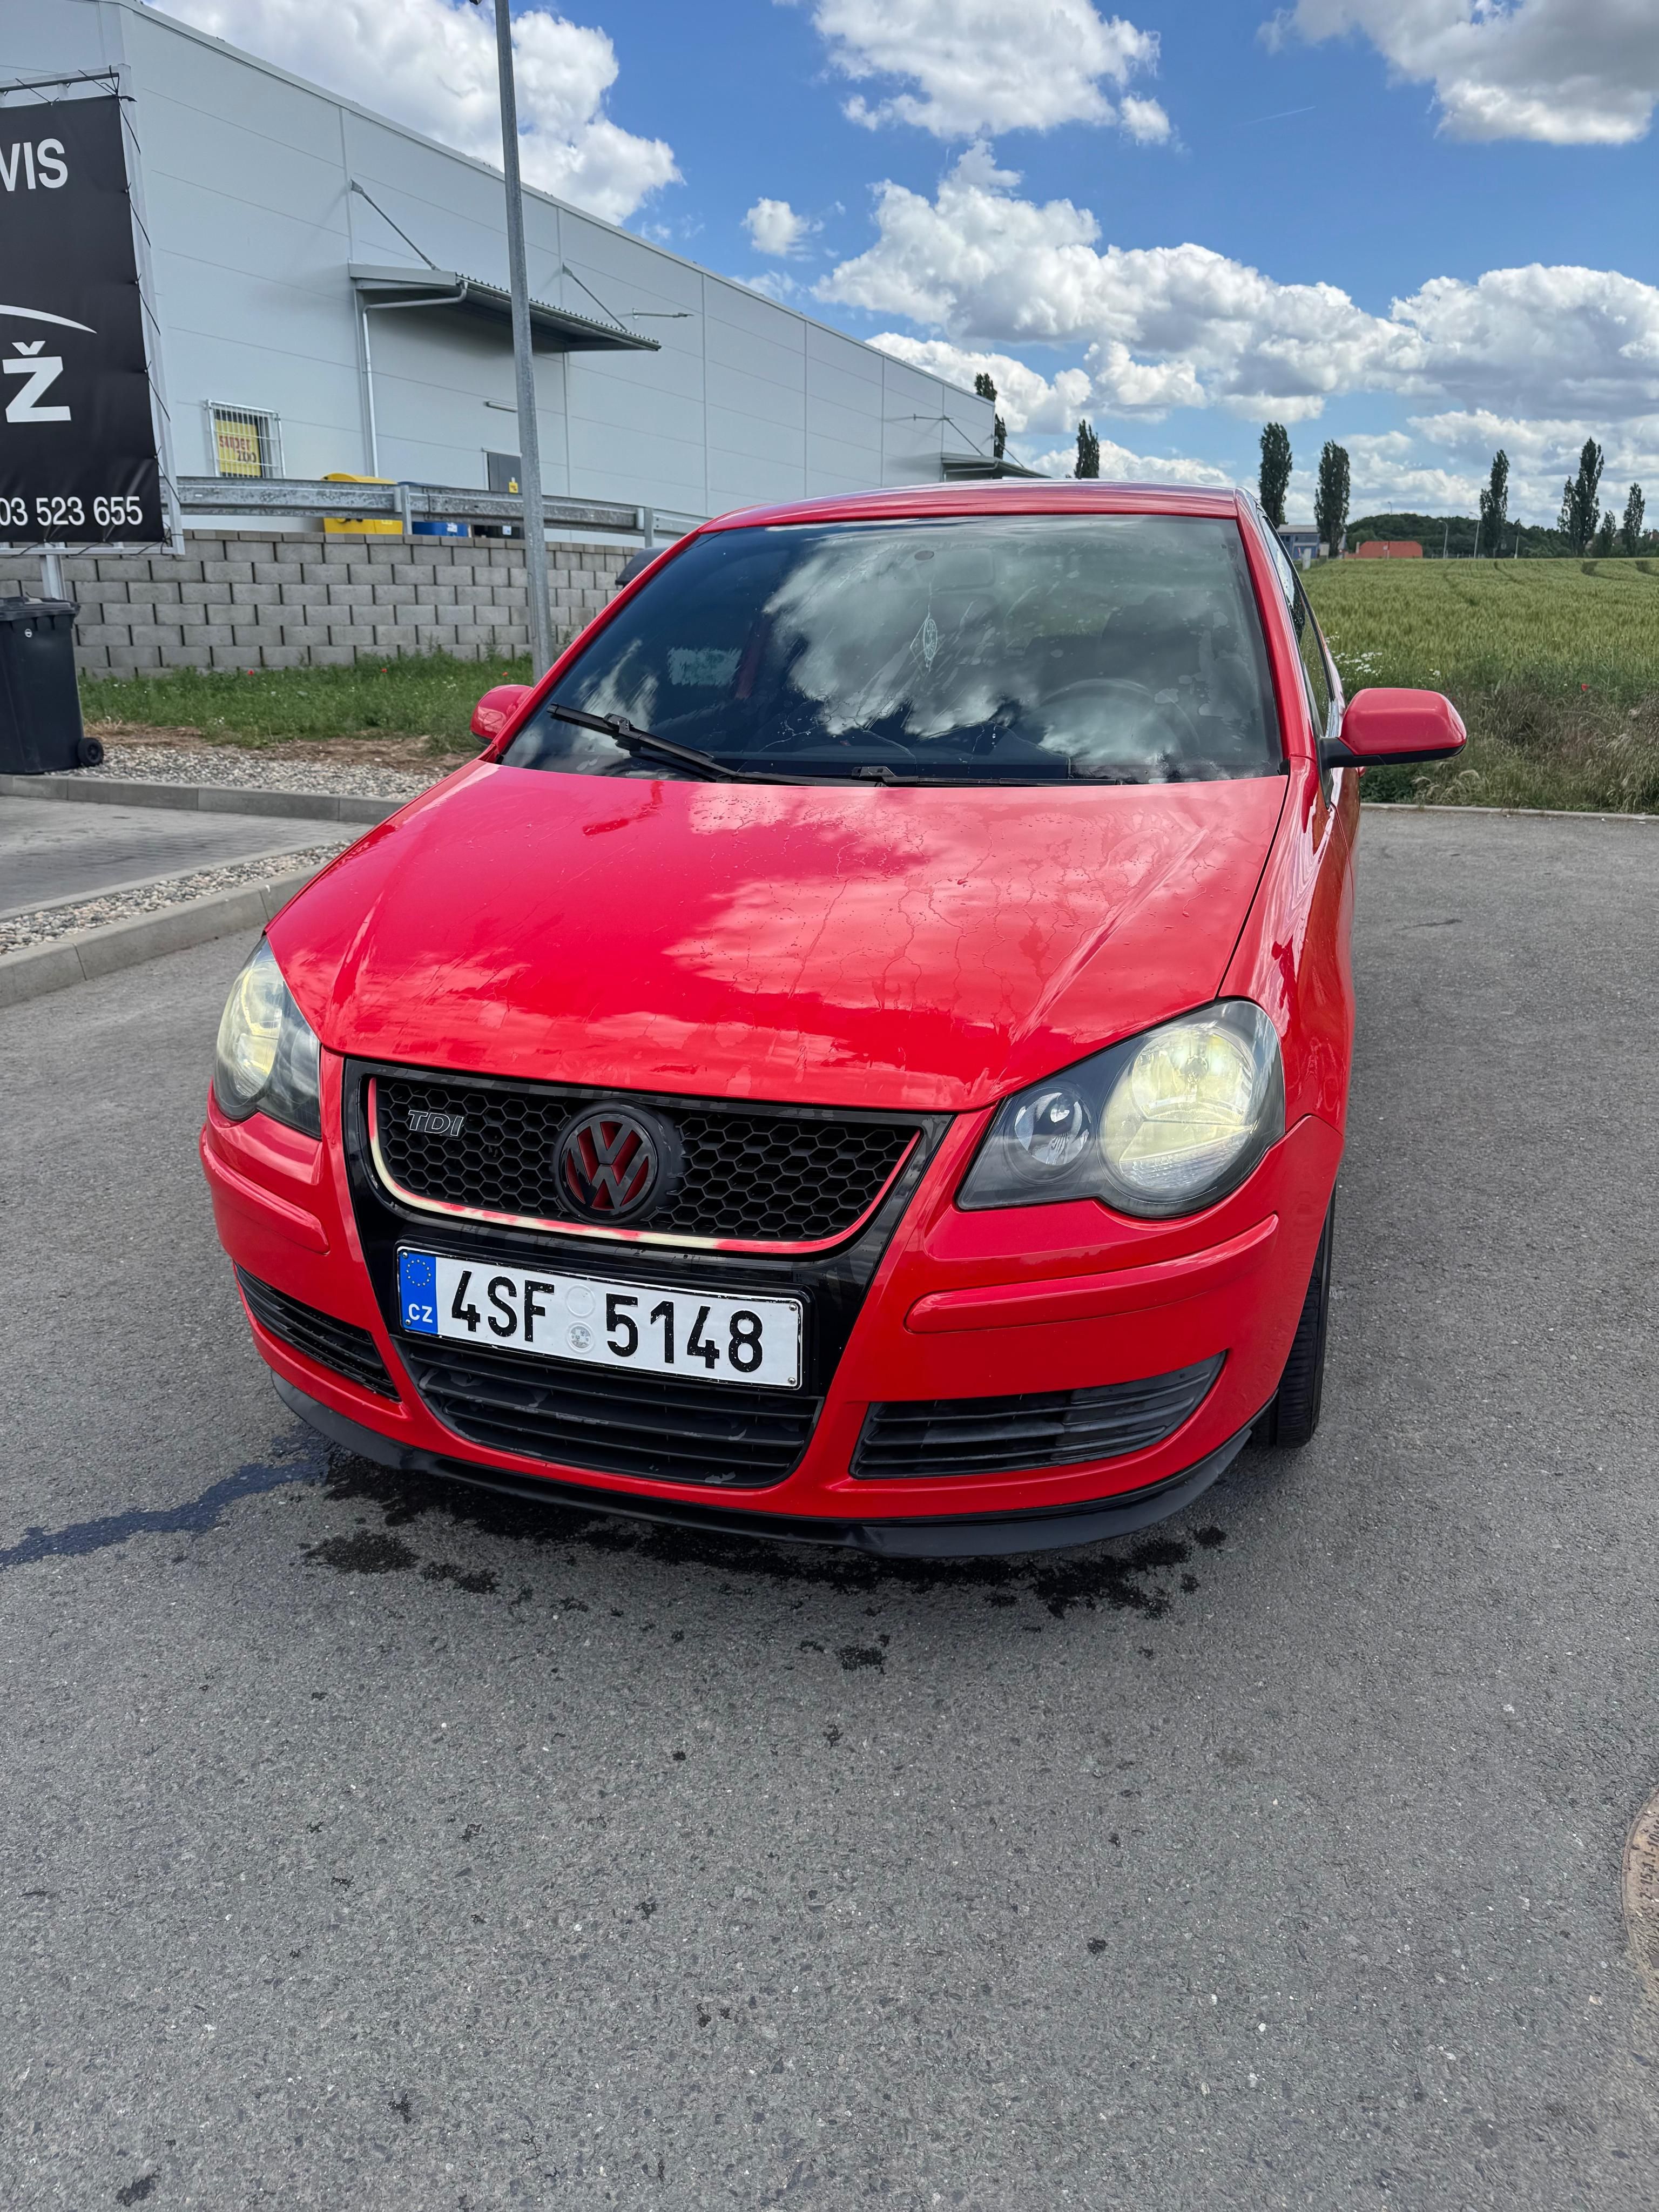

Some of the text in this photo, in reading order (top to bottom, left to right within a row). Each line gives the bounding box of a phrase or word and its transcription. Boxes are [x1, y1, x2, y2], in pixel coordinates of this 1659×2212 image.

[0, 138, 68, 192] VIS
[36, 496, 85, 526] 523
[93, 496, 143, 525] 655
[408, 1110, 464, 1137] TDI
[408, 1303, 433, 1323] CZ
[451, 1271, 763, 1373] 4SF 5148
